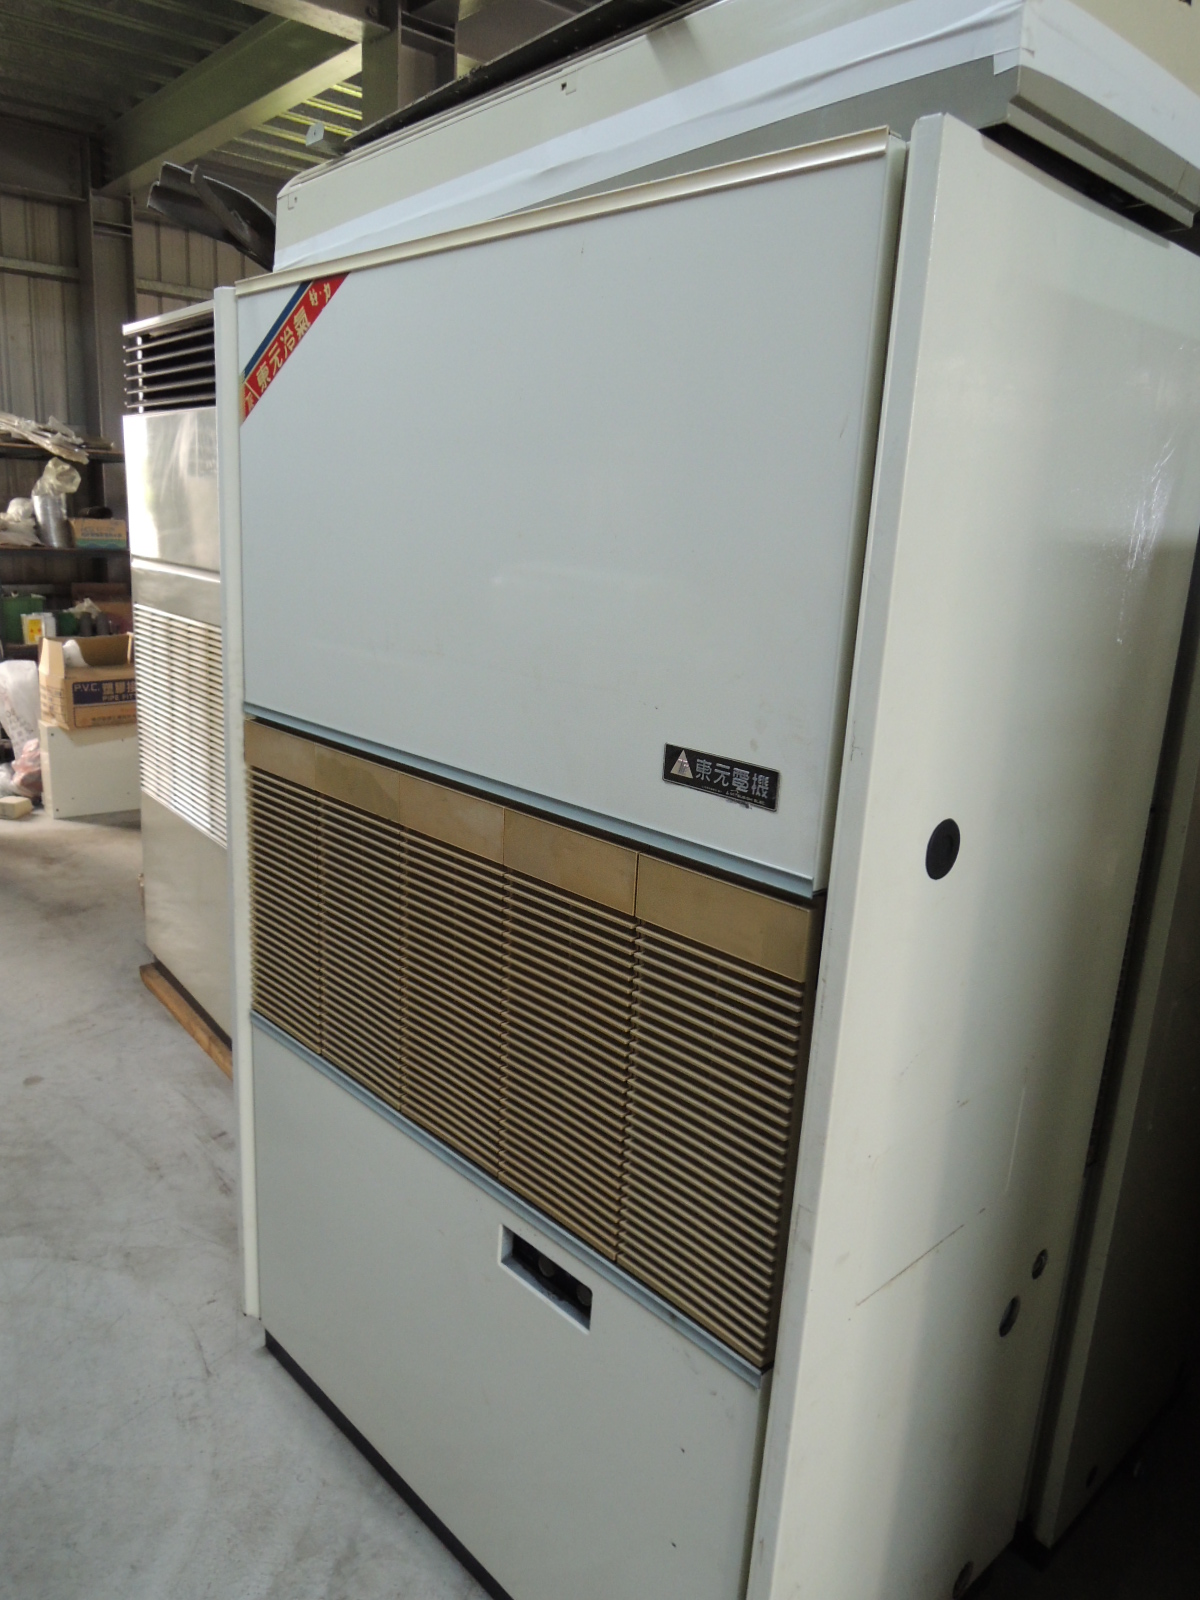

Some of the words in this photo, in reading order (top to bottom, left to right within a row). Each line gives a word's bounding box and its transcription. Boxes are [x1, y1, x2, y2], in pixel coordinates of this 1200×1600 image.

[256, 306, 311, 392] 東元冷氣
[695, 758, 770, 799] 東元電機
